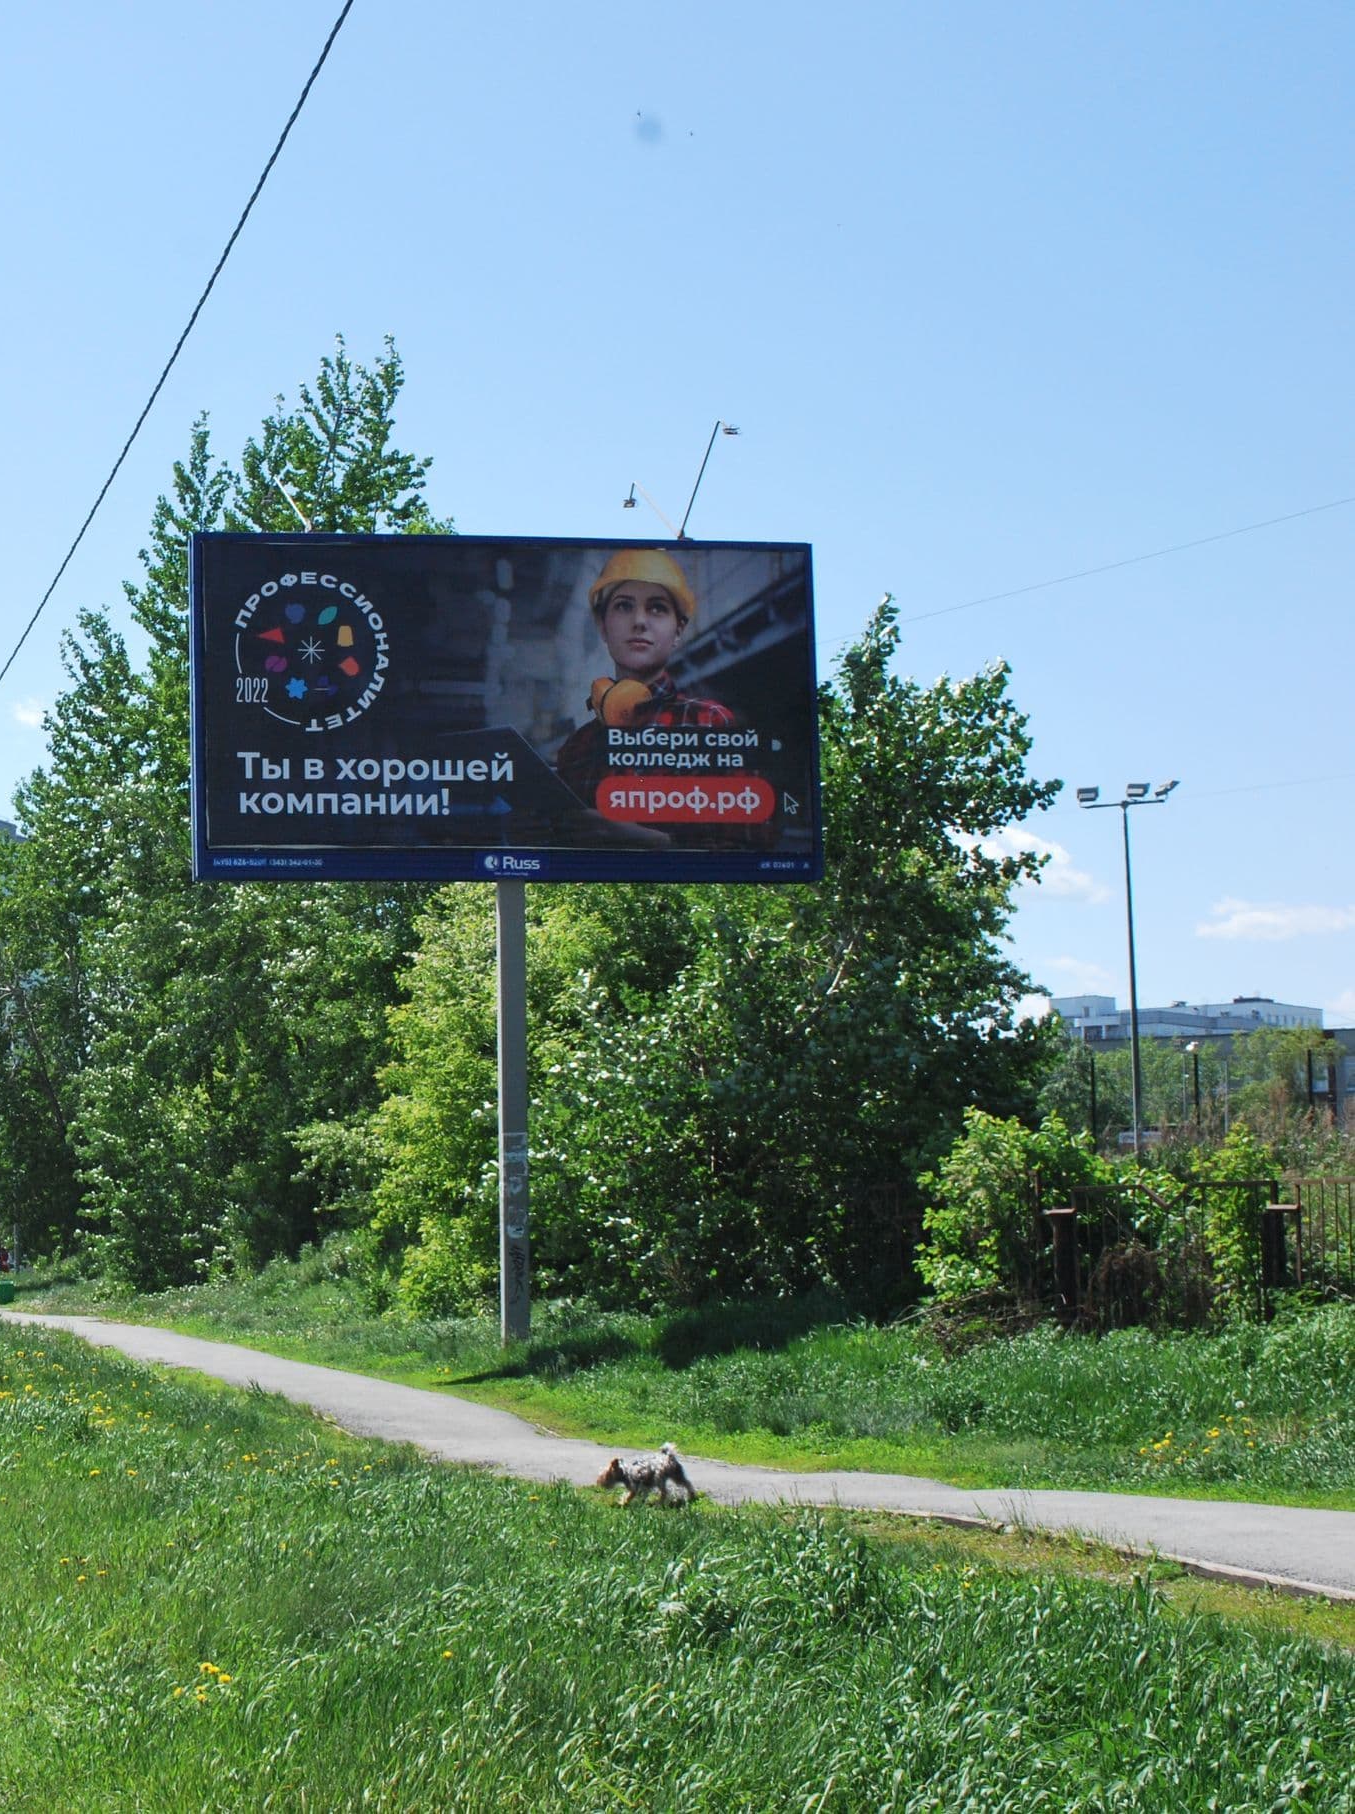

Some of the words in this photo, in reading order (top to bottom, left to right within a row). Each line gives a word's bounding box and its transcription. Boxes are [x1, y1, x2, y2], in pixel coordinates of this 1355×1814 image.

[235, 571, 389, 732] ПРОФЕССИОНАЛИТЕТ
[236, 677, 268, 703] 2022
[608, 729, 700, 749] Выбери
[705, 729, 759, 748] свой
[237, 752, 291, 781] Ты
[304, 758, 324, 780] в
[336, 753, 514, 788] хорошей
[608, 752, 711, 768] колледж
[717, 753, 744, 767] на
[238, 789, 451, 816] компании!
[609, 786, 761, 814] япроф.рф
[502, 856, 541, 870] Russ
